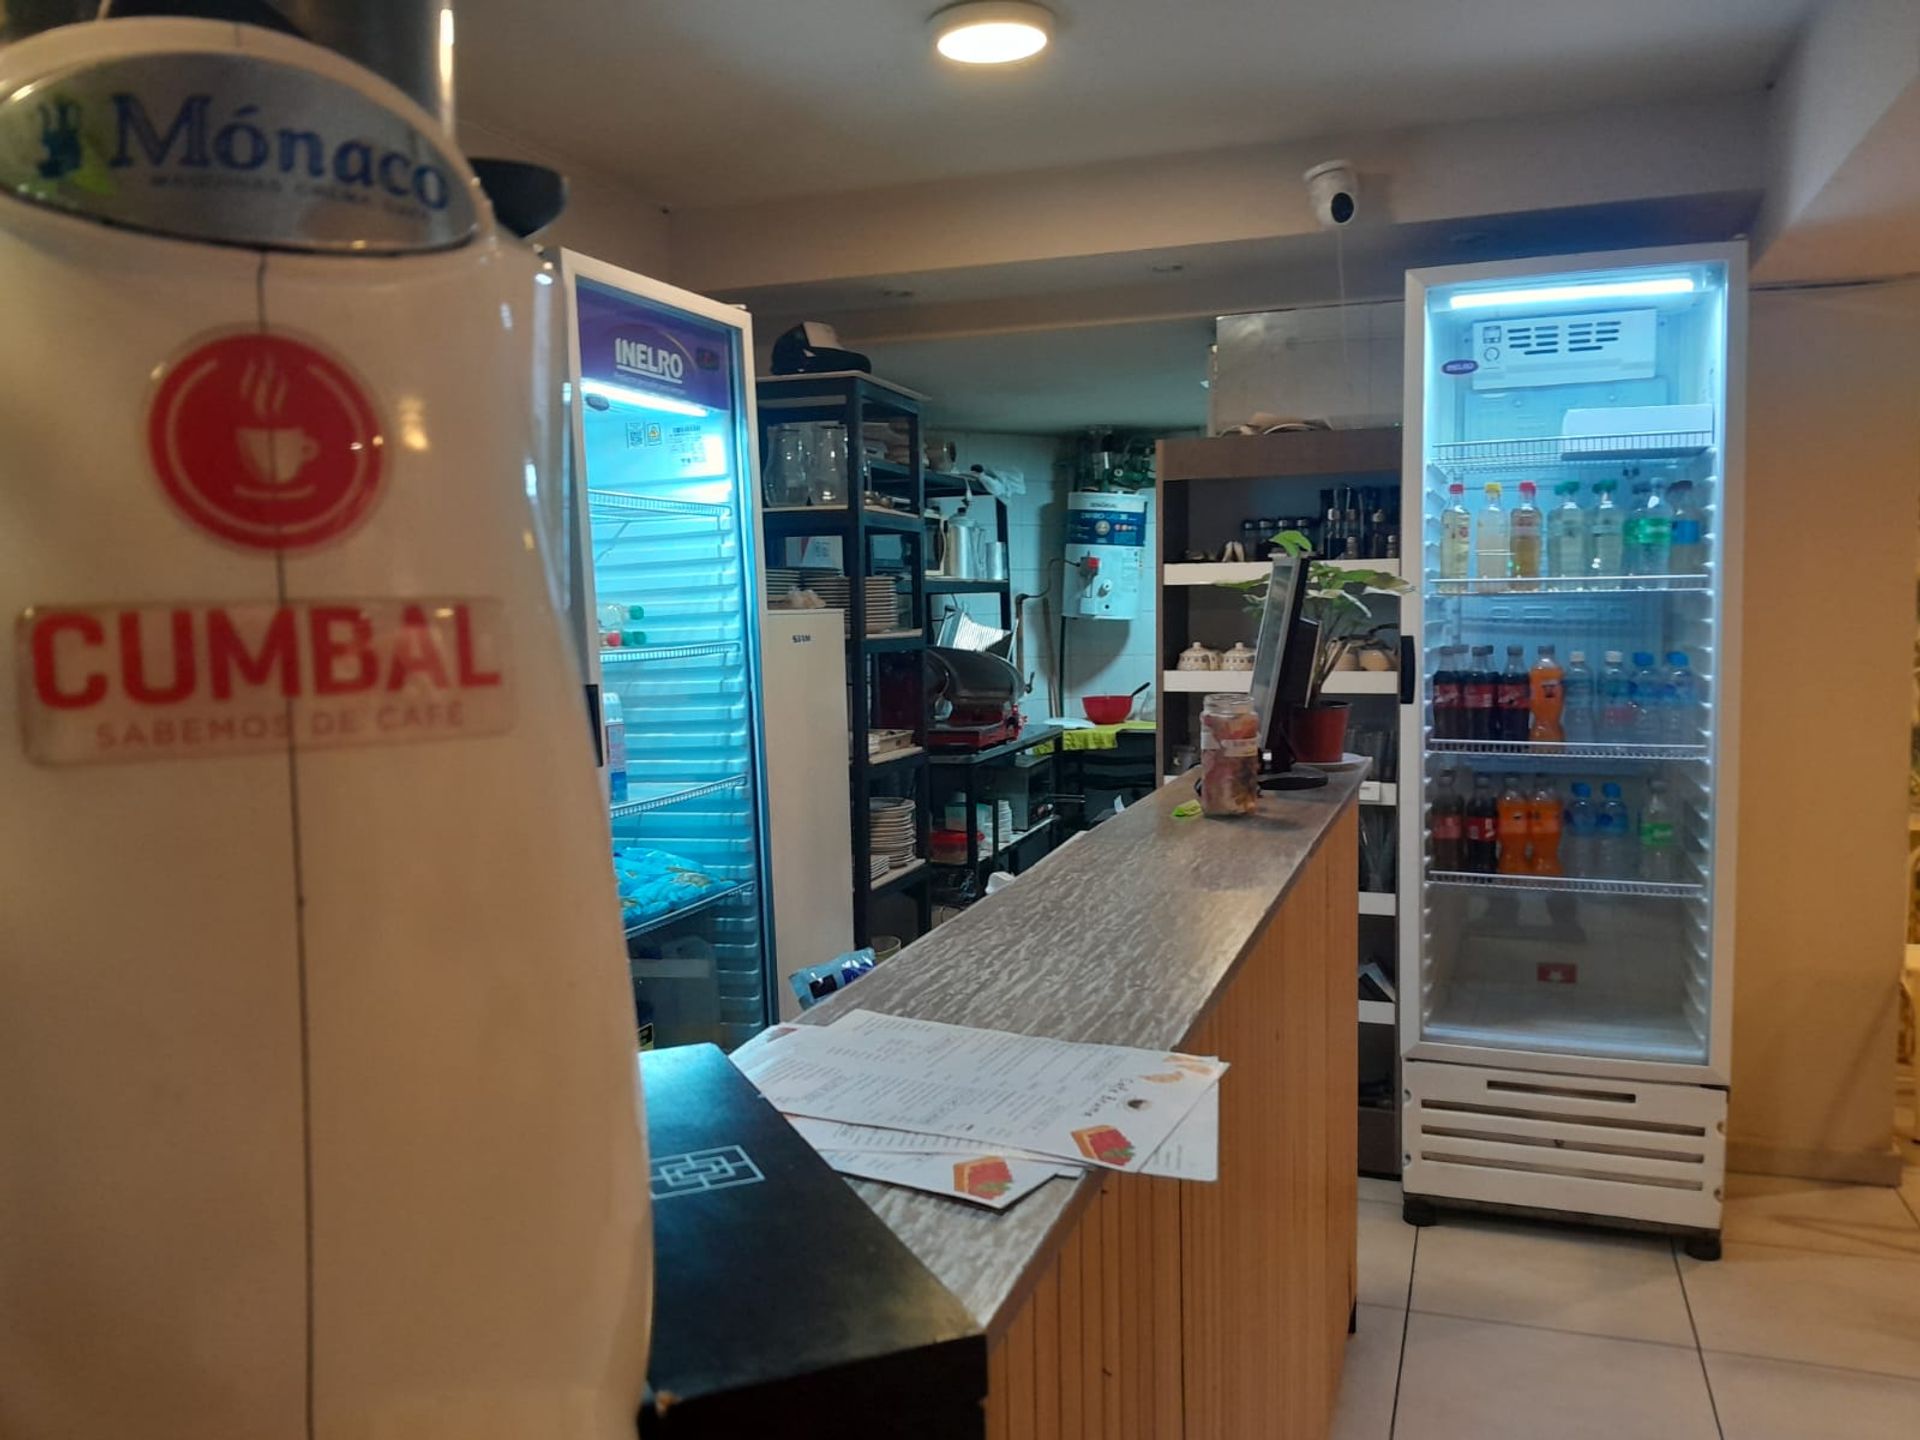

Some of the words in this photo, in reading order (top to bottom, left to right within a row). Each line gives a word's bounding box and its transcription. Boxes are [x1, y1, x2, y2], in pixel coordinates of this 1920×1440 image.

[109, 92, 451, 211] Mónaco
[615, 337, 684, 379] INELRO
[31, 604, 501, 711] CUMBAL
[96, 715, 289, 748] SABEMOS
[311, 709, 358, 736] DE
